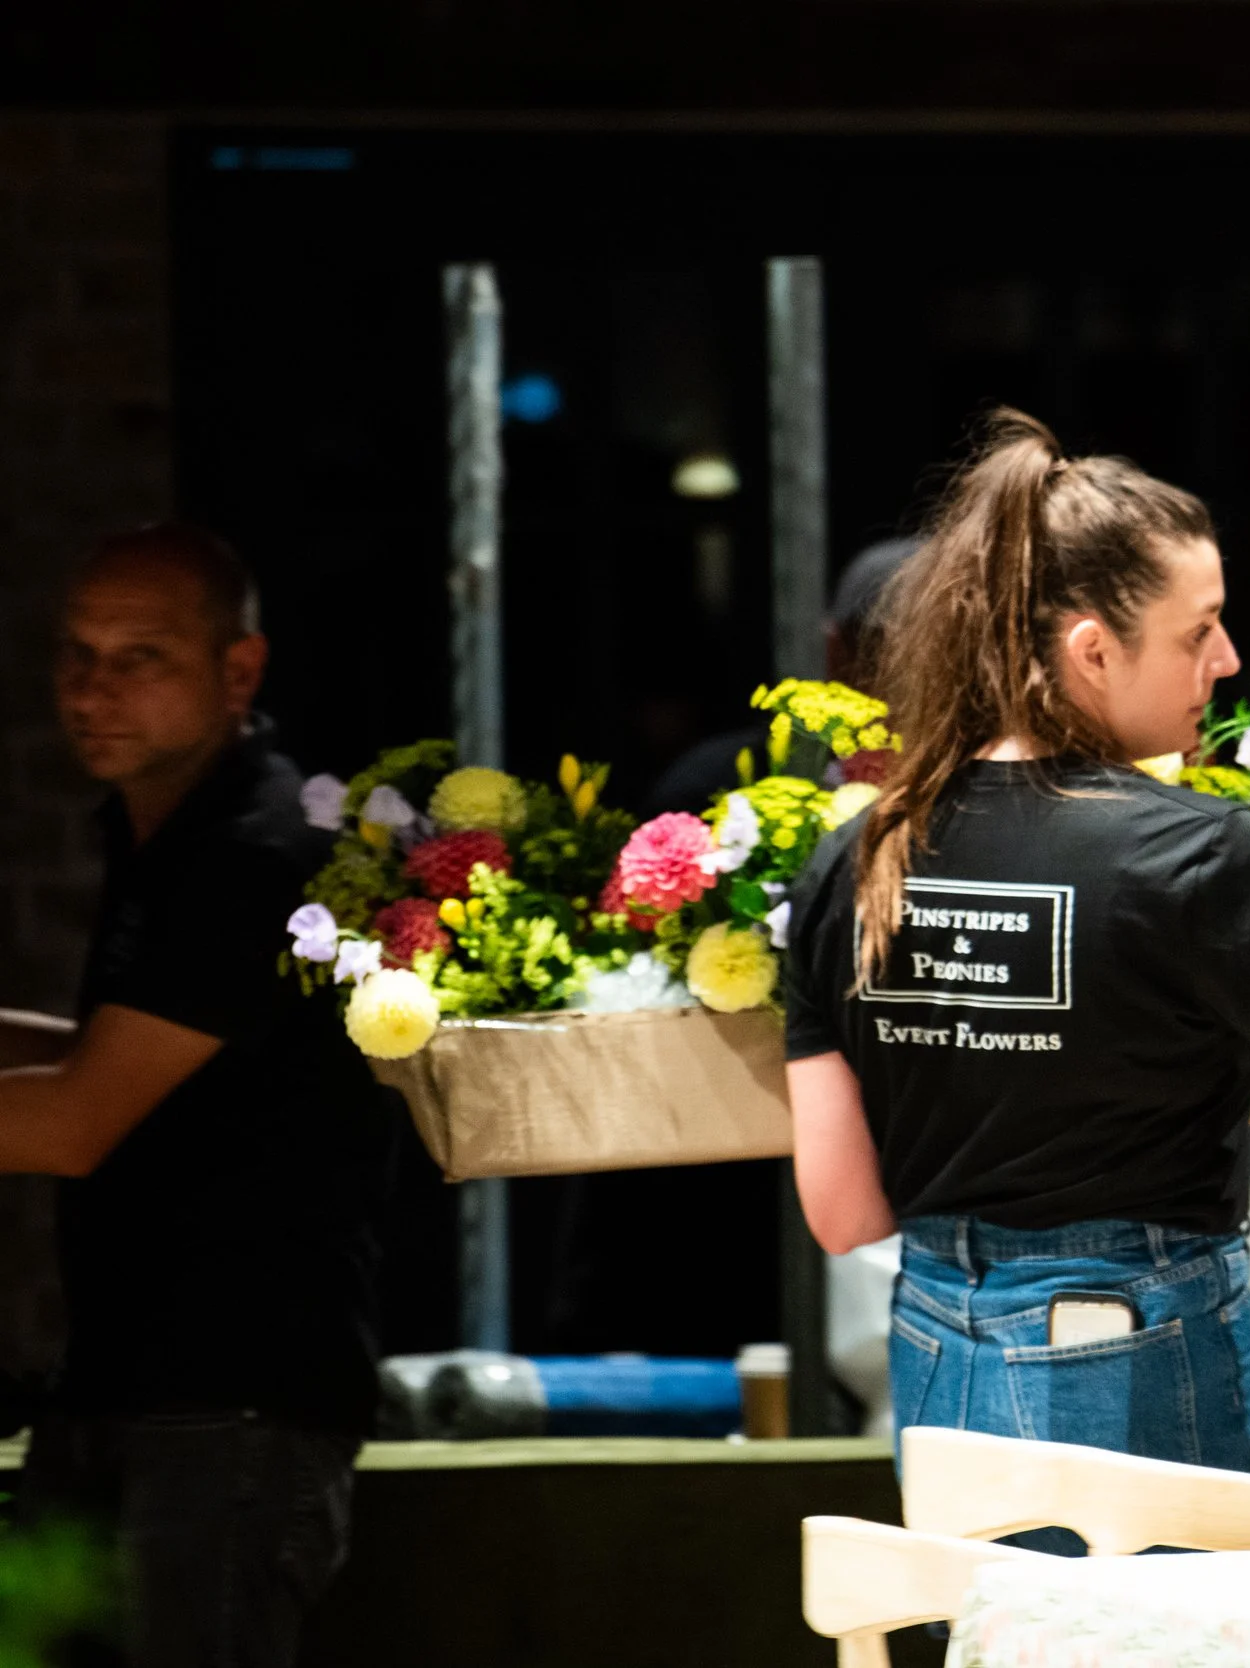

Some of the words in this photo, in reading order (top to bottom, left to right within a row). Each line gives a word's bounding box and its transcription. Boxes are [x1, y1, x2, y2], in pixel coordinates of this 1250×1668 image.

[954, 935, 972, 954] &
[912, 953, 1009, 983] PEONIES
[955, 1022, 1062, 1050] FLOWERS
